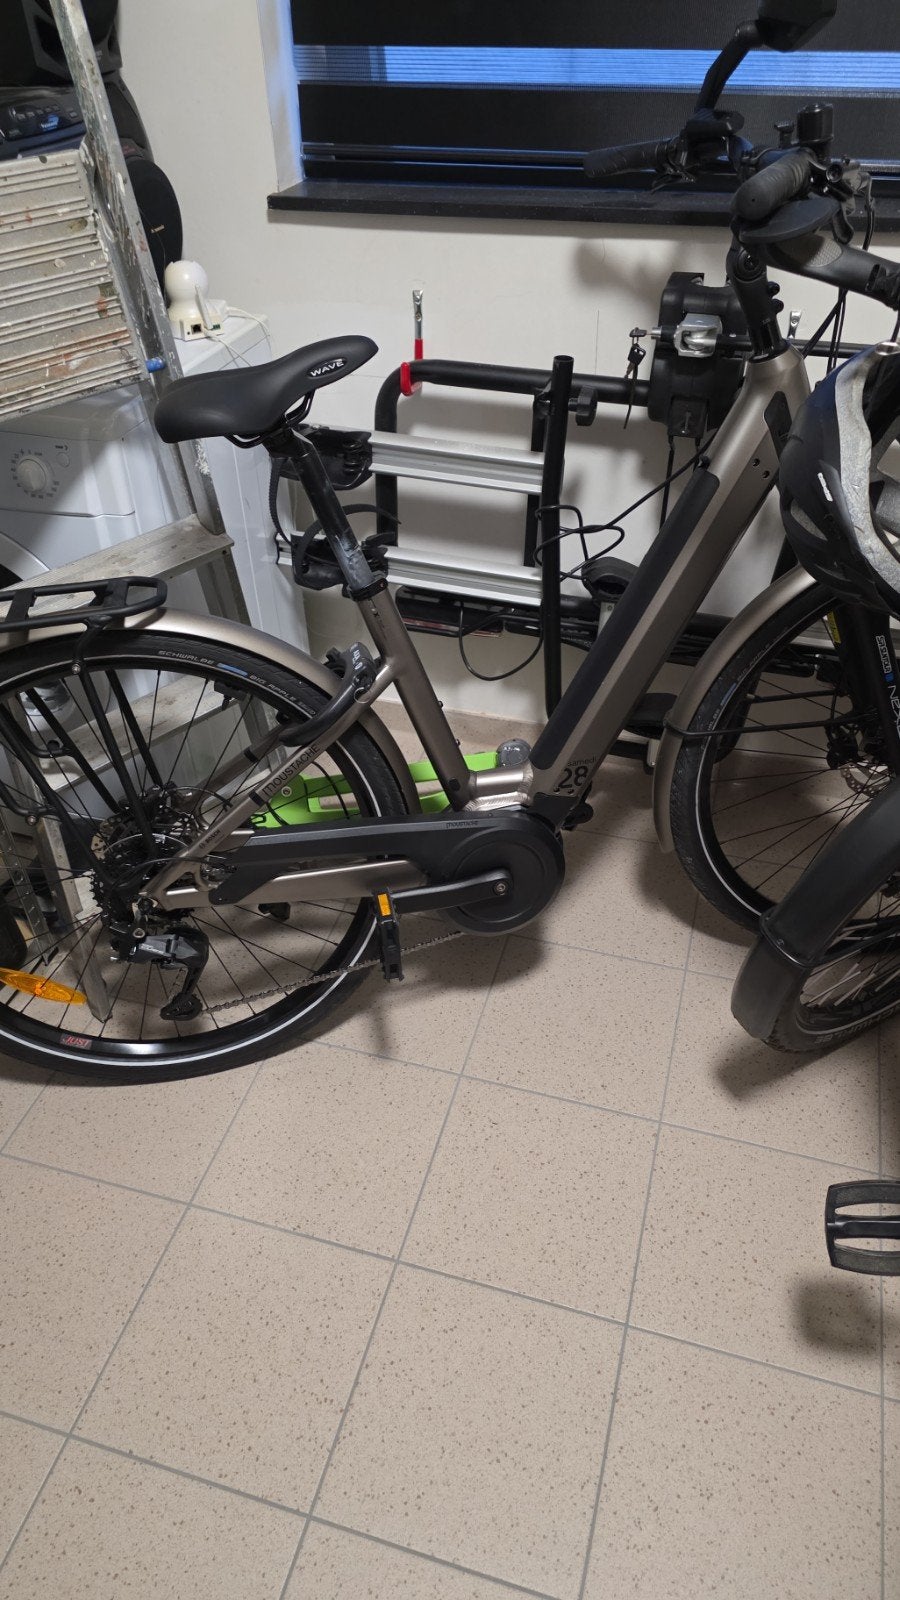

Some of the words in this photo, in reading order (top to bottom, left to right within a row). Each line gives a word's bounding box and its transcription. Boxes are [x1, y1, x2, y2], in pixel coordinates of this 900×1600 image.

[310, 358, 345, 377] WAVE
[157, 650, 216, 665] SCHWALBE
[262, 745, 320, 796] MOUSTACHE
[567, 756, 597, 767] samedi
[557, 765, 589, 789] 28
